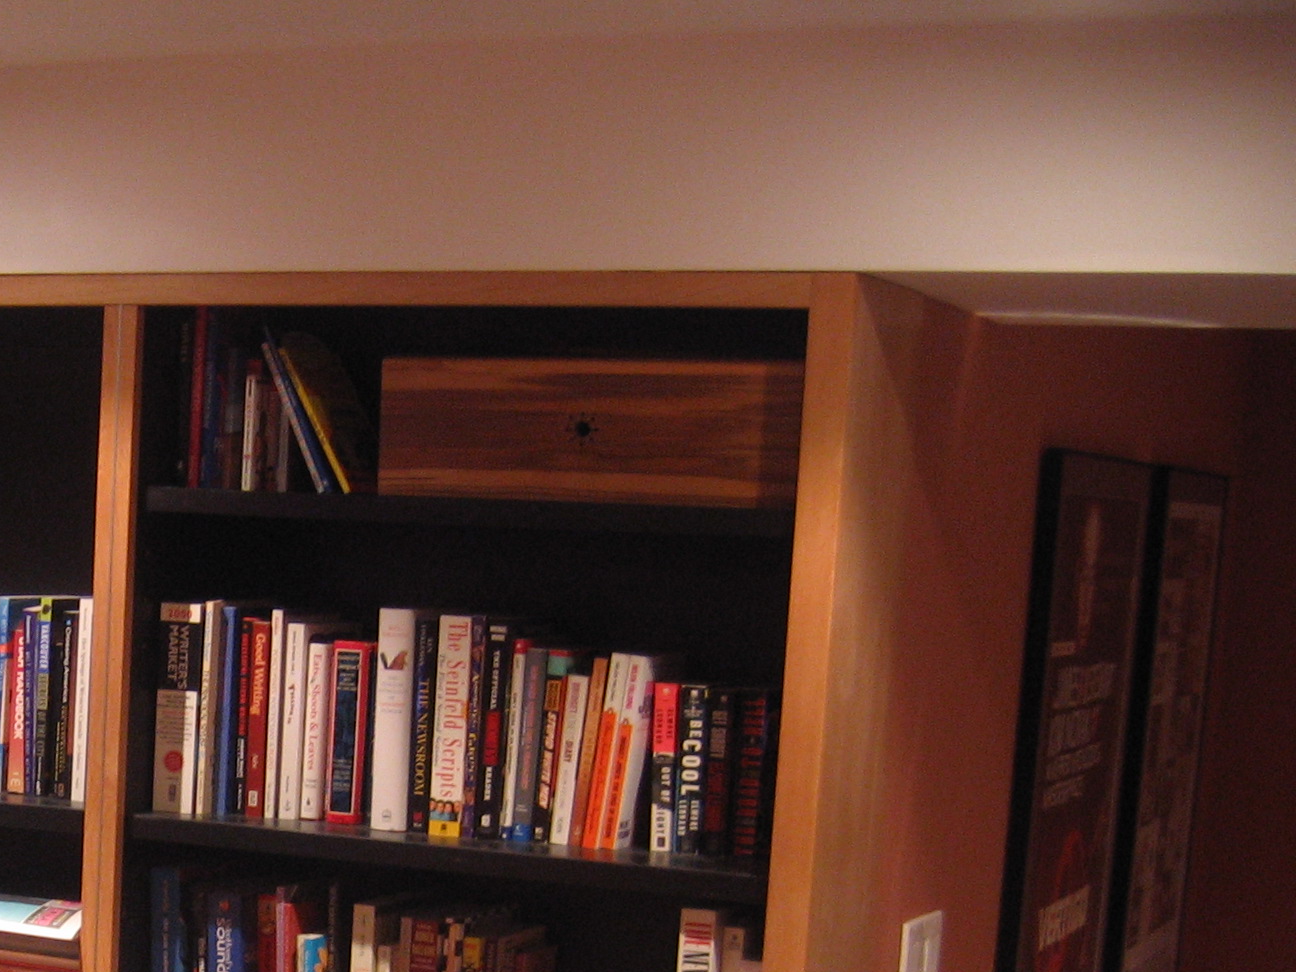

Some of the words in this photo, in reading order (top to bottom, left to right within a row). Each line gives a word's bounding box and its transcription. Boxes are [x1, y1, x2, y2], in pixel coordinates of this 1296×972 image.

[38, 624, 50, 669] VANCOUVER
[62, 627, 73, 666] Crossing
[166, 624, 181, 682] MARKET
[254, 633, 267, 666] Good
[446, 621, 470, 652] The
[175, 624, 191, 691] WRITER'S
[491, 651, 501, 668] THE
[61, 666, 71, 704] America
[249, 668, 265, 715] Writing
[309, 685, 322, 720] Shoots
[416, 678, 431, 709] THE
[441, 662, 467, 730] Seinfeld
[489, 670, 500, 710] OFFICIAL
[13, 672, 25, 740] HANDBOOK
[544, 711, 558, 750] STUPID
[688, 719, 703, 738] BE
[306, 735, 319, 771] Leaves
[412, 713, 430, 796] NEWSROOM
[434, 739, 461, 799] Scripts
[564, 740, 575, 763] DIARY
[679, 738, 702, 796] COOL
[660, 766, 672, 785] OUT
[538, 783, 550, 809] MEN
[659, 789, 671, 803] OF
[677, 799, 689, 836] LEONARD
[689, 799, 701, 831] ELMORE
[684, 922, 713, 946] THE
